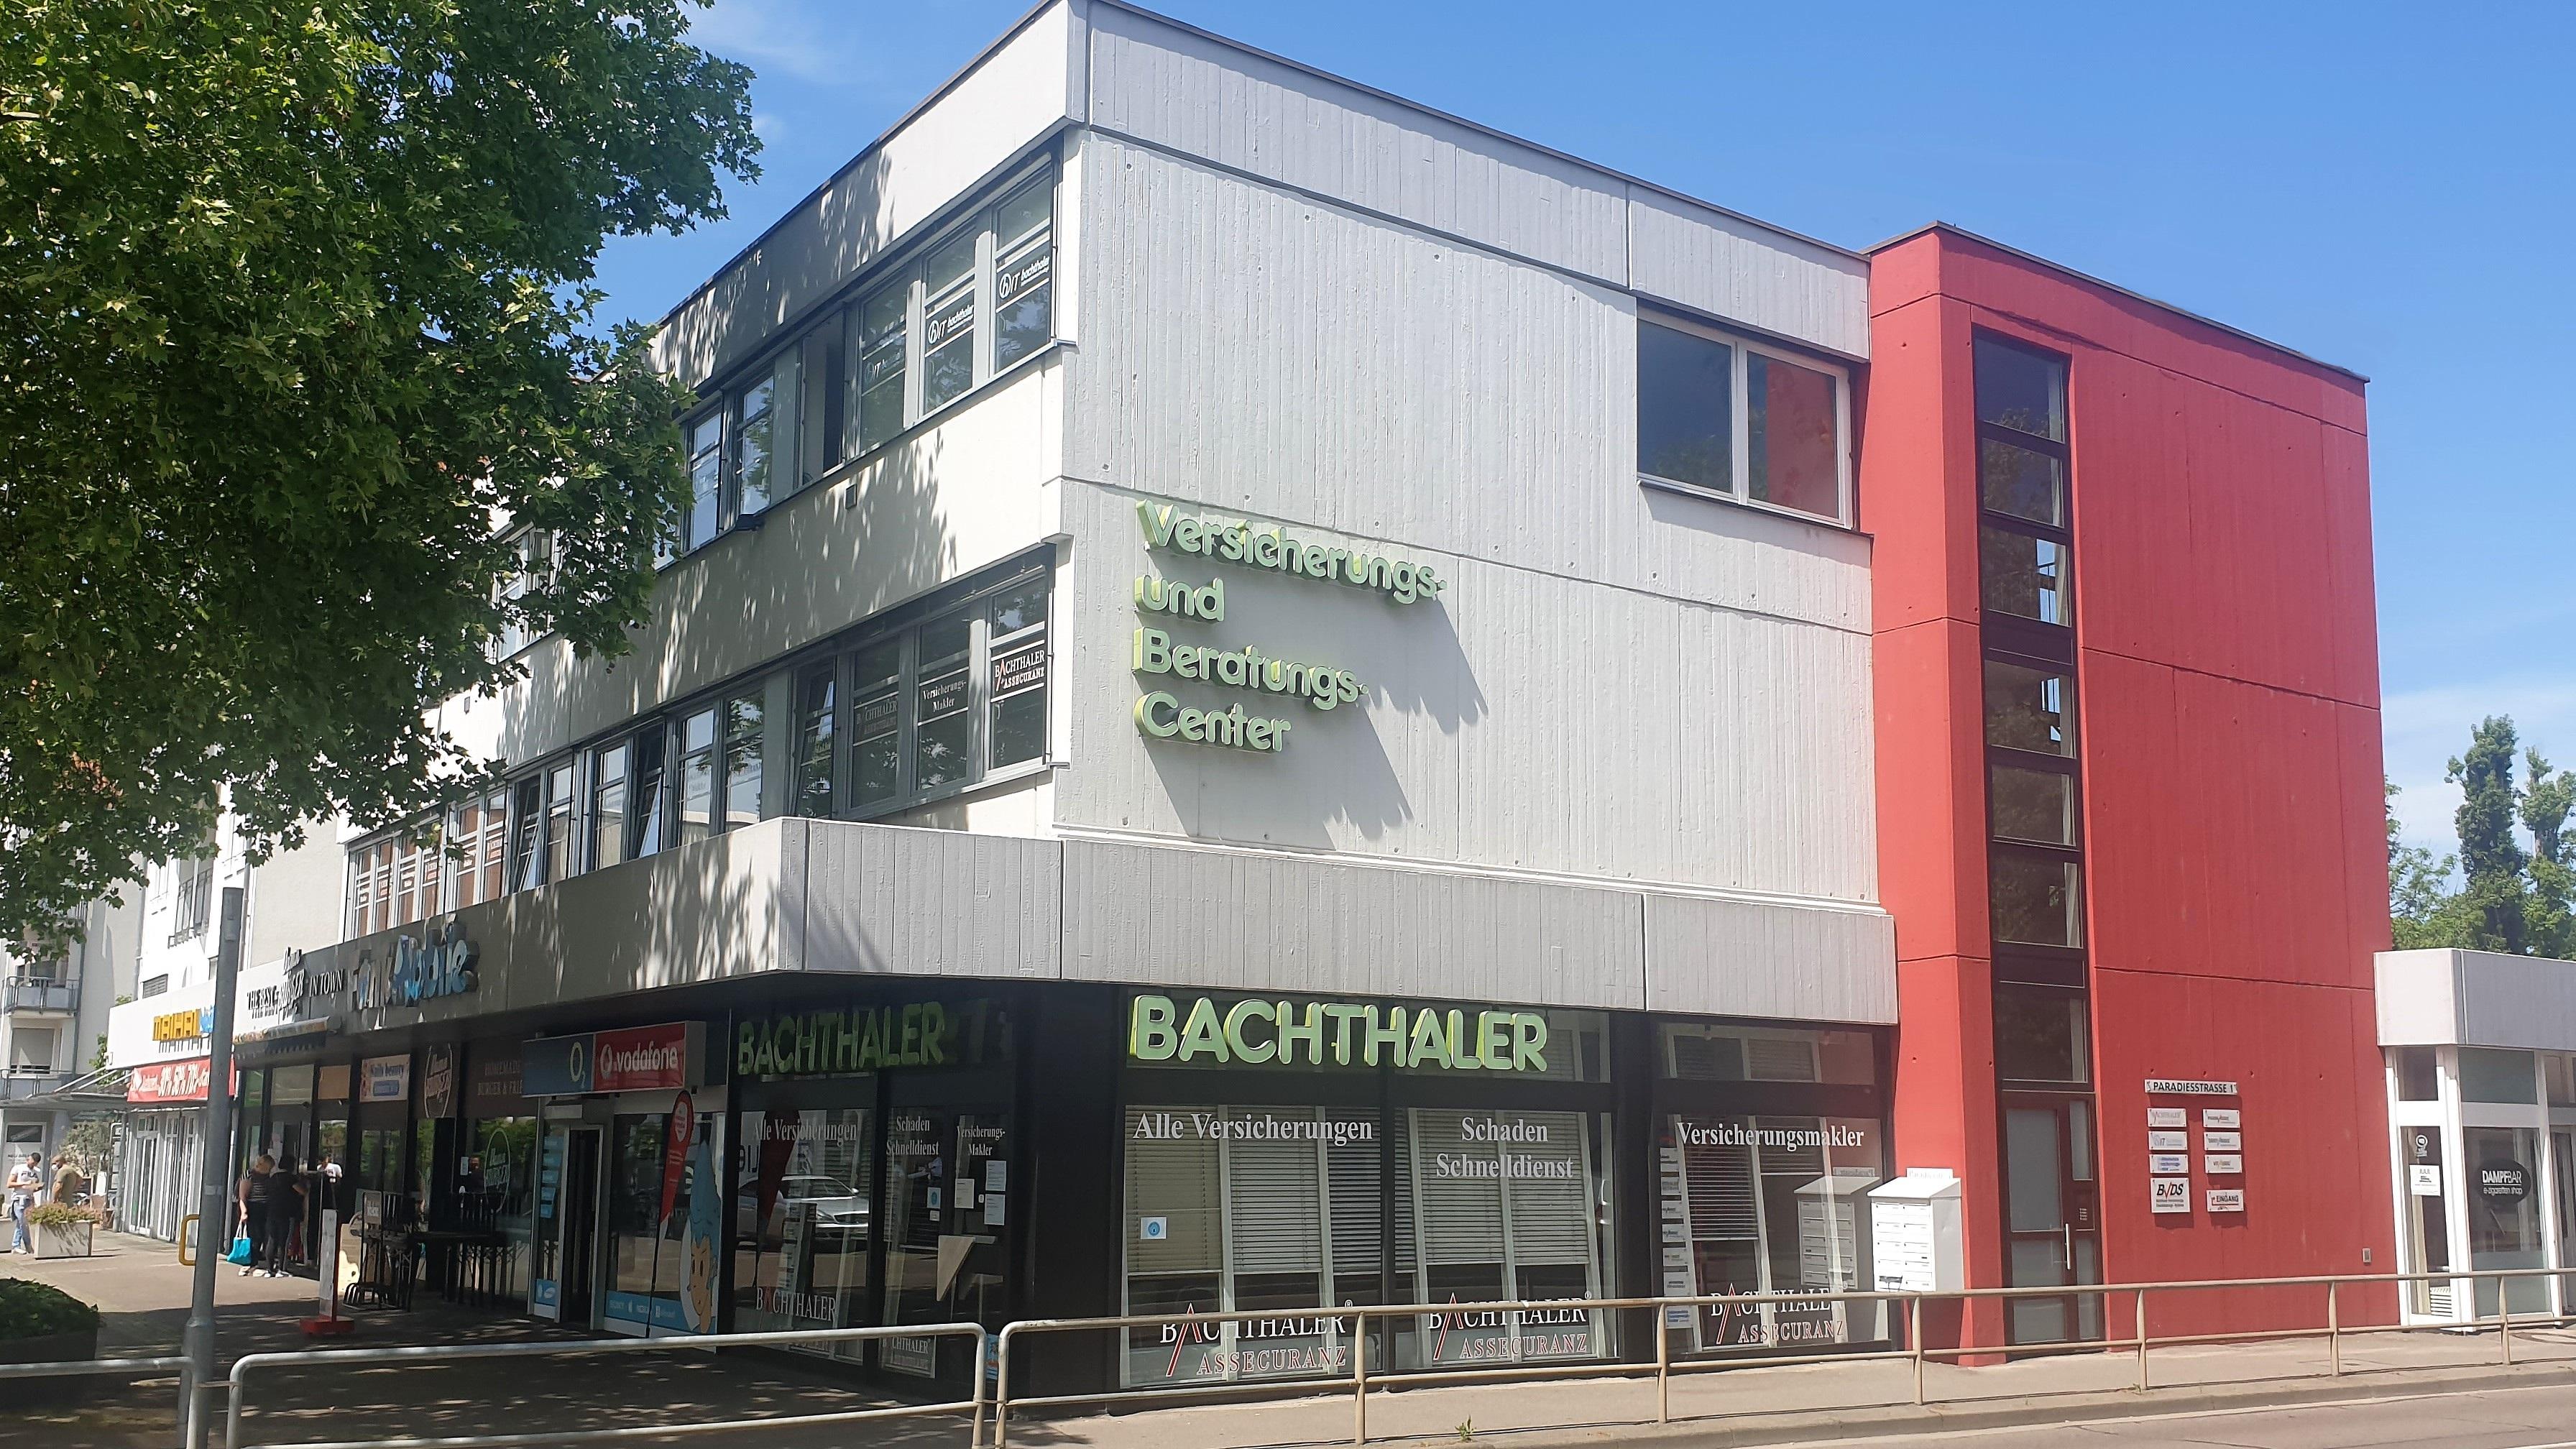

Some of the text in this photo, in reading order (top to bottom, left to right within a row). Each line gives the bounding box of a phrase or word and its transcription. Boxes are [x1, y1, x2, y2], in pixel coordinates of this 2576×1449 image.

[995, 650, 1045, 691] BACHTHALER
[1003, 667, 1044, 689] ASSECURANZ
[922, 680, 967, 700] Versicherungs-
[857, 700, 898, 725] BCHTHALER
[933, 698, 954, 712] Makler
[1133, 691, 1292, 753] Center
[737, 1000, 945, 1076] BACHTHALER
[1129, 994, 1548, 1072] BACHTHALER
[616, 1041, 678, 1072] vodafone
[2153, 1082, 2227, 1093] PARADIESSTRASSE
[755, 1119, 857, 1146] Alle Versicherungen
[896, 1116, 931, 1133] Schaden
[957, 1123, 1006, 1139] Versicherungs-
[1133, 1113, 1374, 1146] Alle Versicherungen
[1460, 1116, 1549, 1143] Schaden
[1676, 1121, 1865, 1151] Versicherungsmakler
[886, 1139, 939, 1157] Schnelldienst
[967, 1144, 993, 1156] Makler
[1436, 1153, 1574, 1179] Schnelldienst
[2482, 1169, 2523, 1184] DAMPFBAR
[2216, 1195, 2239, 1203] EINGANG
[1737, 1319, 1844, 1343] ASSECURANZ
[882, 1336, 929, 1354] BCHTHALER
[1459, 1333, 1587, 1359] ASSECURANZ
[1196, 1346, 1347, 1375] ASSECURANZ
